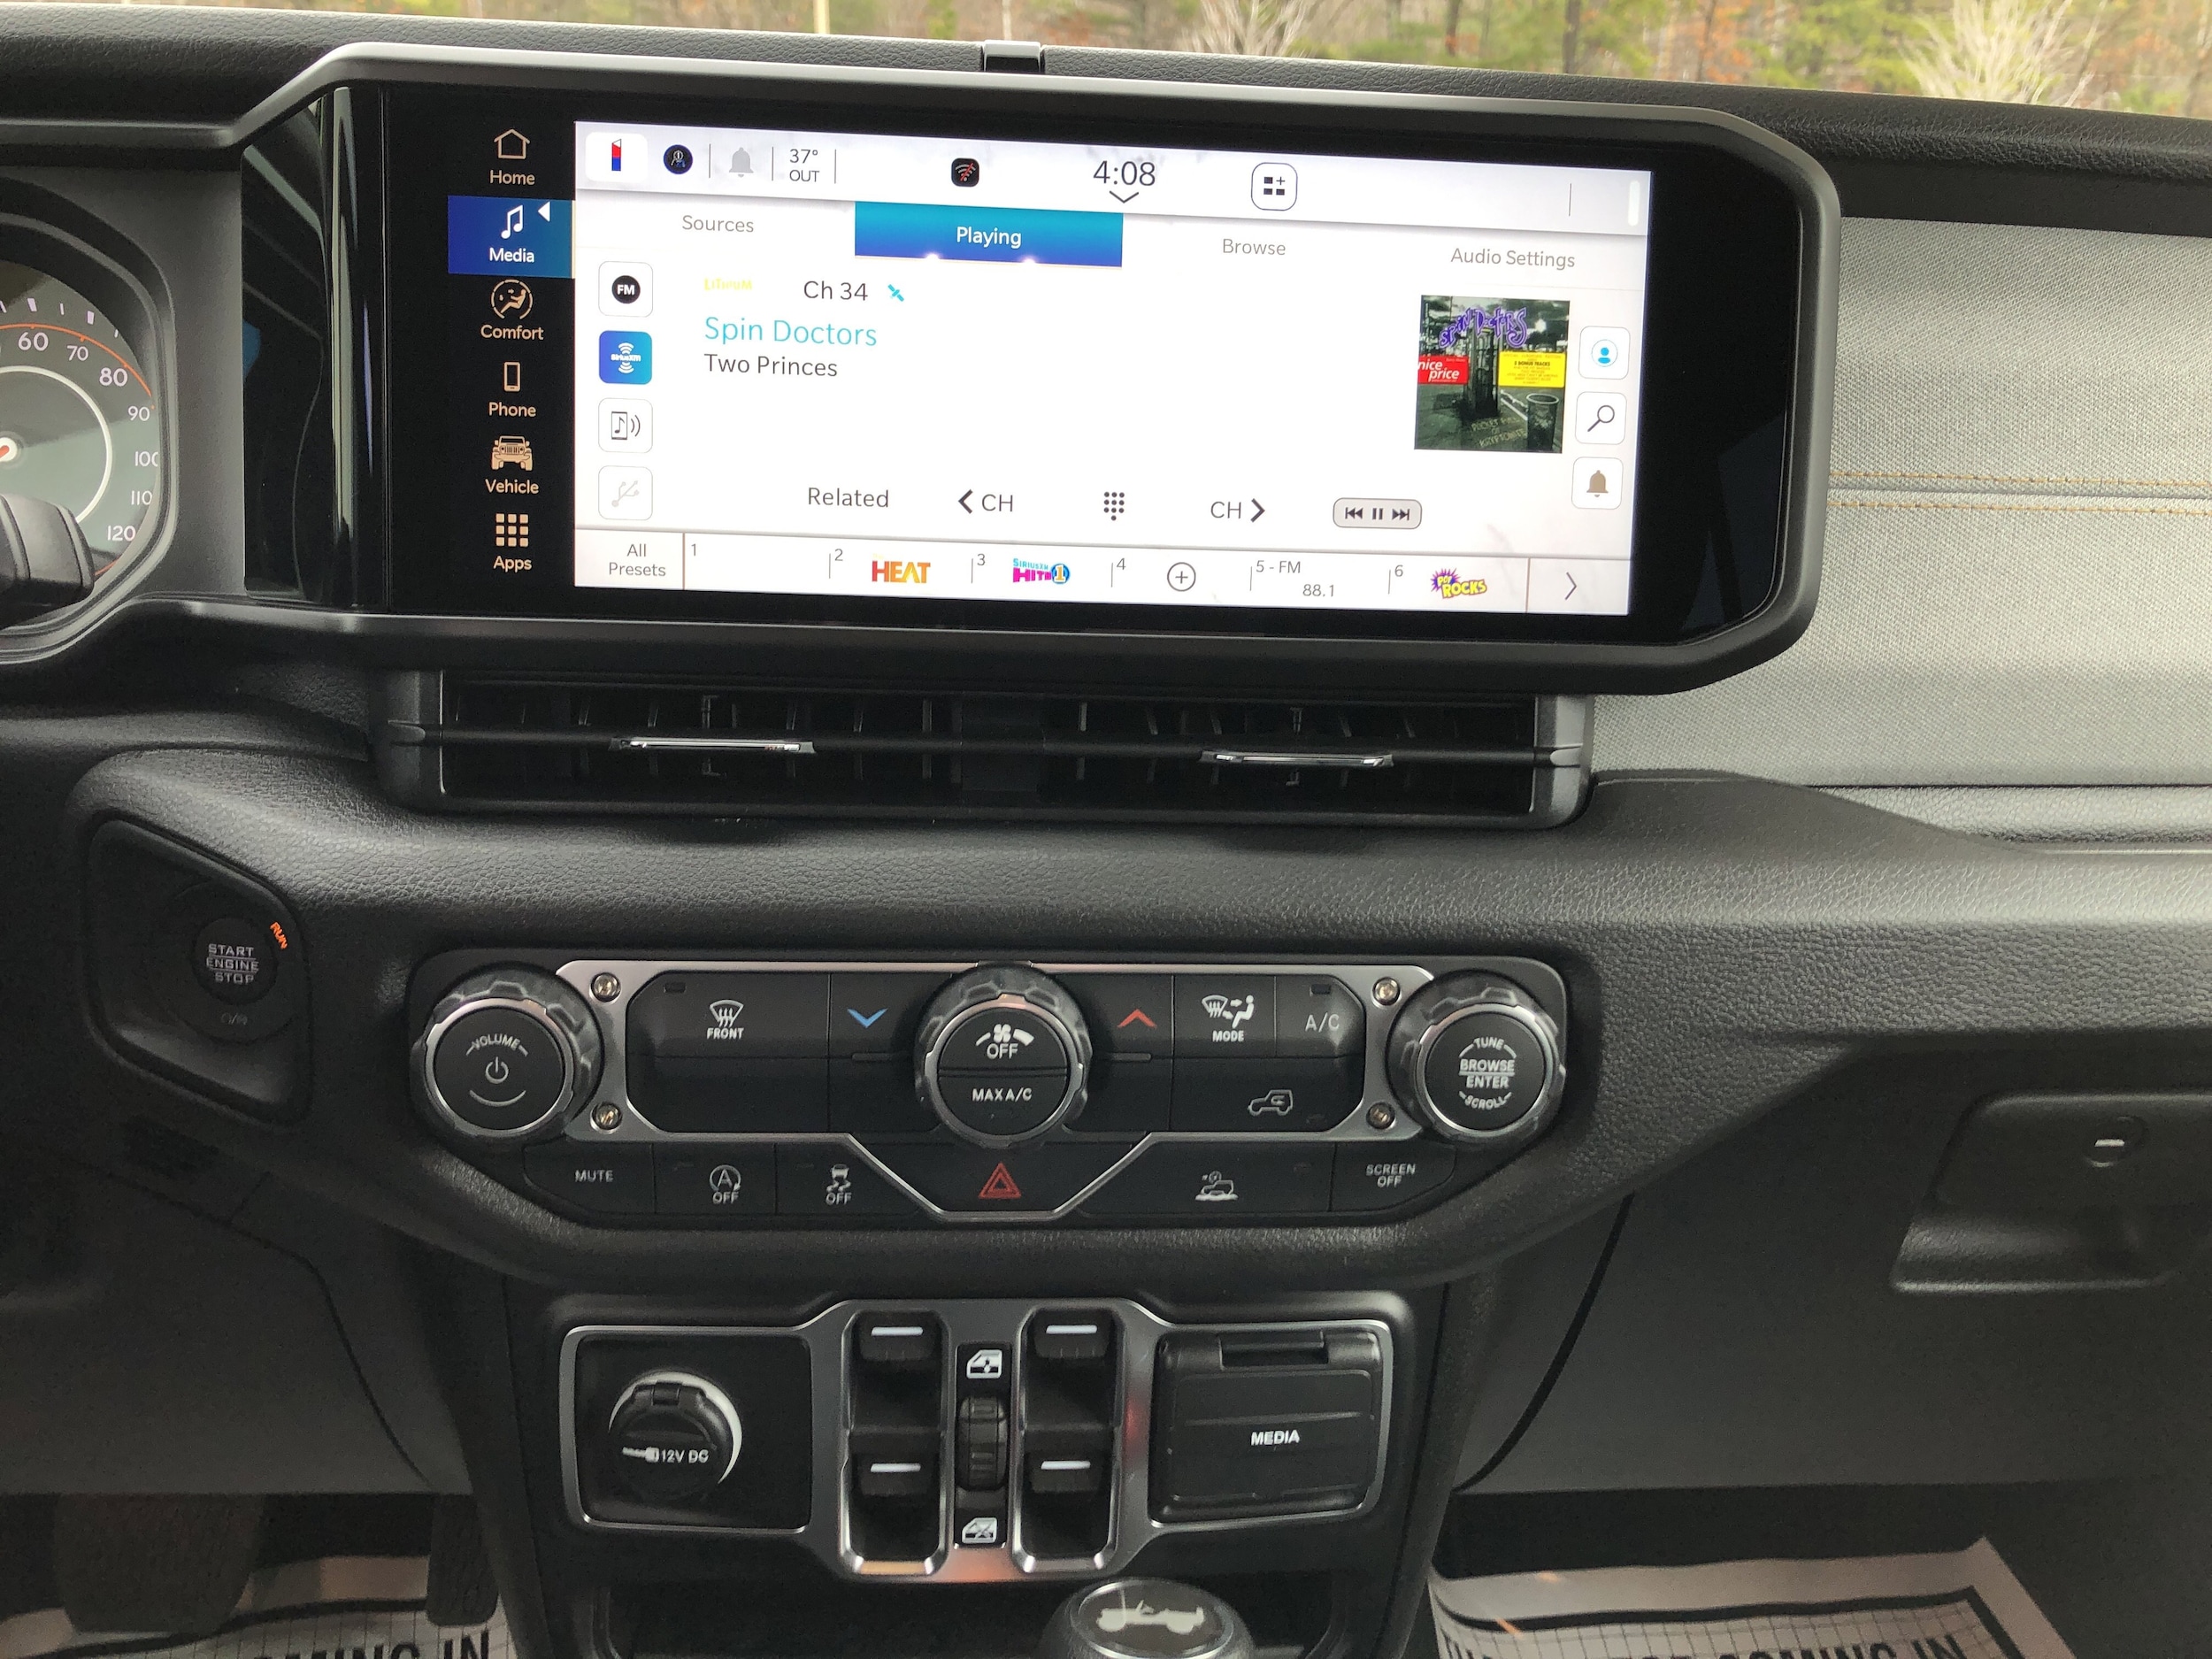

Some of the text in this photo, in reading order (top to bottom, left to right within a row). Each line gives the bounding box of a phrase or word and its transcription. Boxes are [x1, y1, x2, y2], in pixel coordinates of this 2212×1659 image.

[489, 170, 535, 185] Home
[789, 169, 820, 183] OUT
[1094, 160, 1156, 187] 4:08
[682, 215, 755, 234] Sources
[956, 227, 1021, 249] Playing
[489, 247, 535, 263] Media
[1223, 238, 1286, 256] Browse
[1451, 248, 1576, 271] Audio Settings
[617, 284, 635, 296] FM
[803, 280, 869, 302] Ch 34
[480, 324, 544, 341] Comfort
[705, 317, 878, 347] Spin Doctors
[18, 331, 49, 351] 60
[66, 345, 89, 361] 70
[704, 353, 839, 378] Two Princes
[1417, 358, 1443, 370] nice
[99, 367, 128, 387] 80
[1428, 367, 1460, 382] price
[127, 405, 150, 421] 90
[488, 402, 536, 418] Phone
[485, 479, 539, 495] Vehicle
[130, 490, 153, 505] 110
[807, 487, 889, 509] Related
[981, 494, 1014, 512] CH
[1210, 501, 1242, 519] CH
[107, 526, 136, 541] 120
[626, 542, 647, 557] All
[691, 543, 697, 557] 1
[834, 549, 843, 562] 2
[493, 556, 532, 572] Apps
[977, 554, 986, 566] 3
[1117, 557, 1126, 571] 4
[1256, 560, 1264, 573] 5
[1279, 561, 1302, 574] FM
[609, 561, 666, 578] Presets
[872, 560, 931, 584] HEAT
[1394, 565, 1403, 577] 6
[1302, 583, 1334, 597] 88.1
[1441, 579, 1487, 599] ROCKS
[270, 921, 288, 949] RUN
[208, 943, 255, 957] START
[205, 956, 259, 972] ENGINE
[215, 972, 254, 985] STOP
[1305, 1014, 1340, 1033] A/C
[706, 1026, 744, 1041] FRONT
[1212, 1030, 1245, 1043] MODE
[471, 1034, 521, 1051] VOLUME
[1473, 1037, 1505, 1051] TUNE
[987, 1042, 1018, 1060] OFF
[1460, 1059, 1515, 1072] BROWSE
[1465, 1075, 1509, 1089] ENTER
[972, 1087, 1033, 1102] MAX A/C
[1463, 1094, 1506, 1111] SCROLL
[575, 1169, 614, 1183] MUTE
[1366, 1164, 1416, 1176] SCREEN
[1377, 1176, 1402, 1187] OFF
[712, 1191, 739, 1204] OFF
[825, 1192, 852, 1205] OFF
[1250, 1430, 1301, 1446] MEDIA
[661, 1448, 709, 1463] 12V DC
